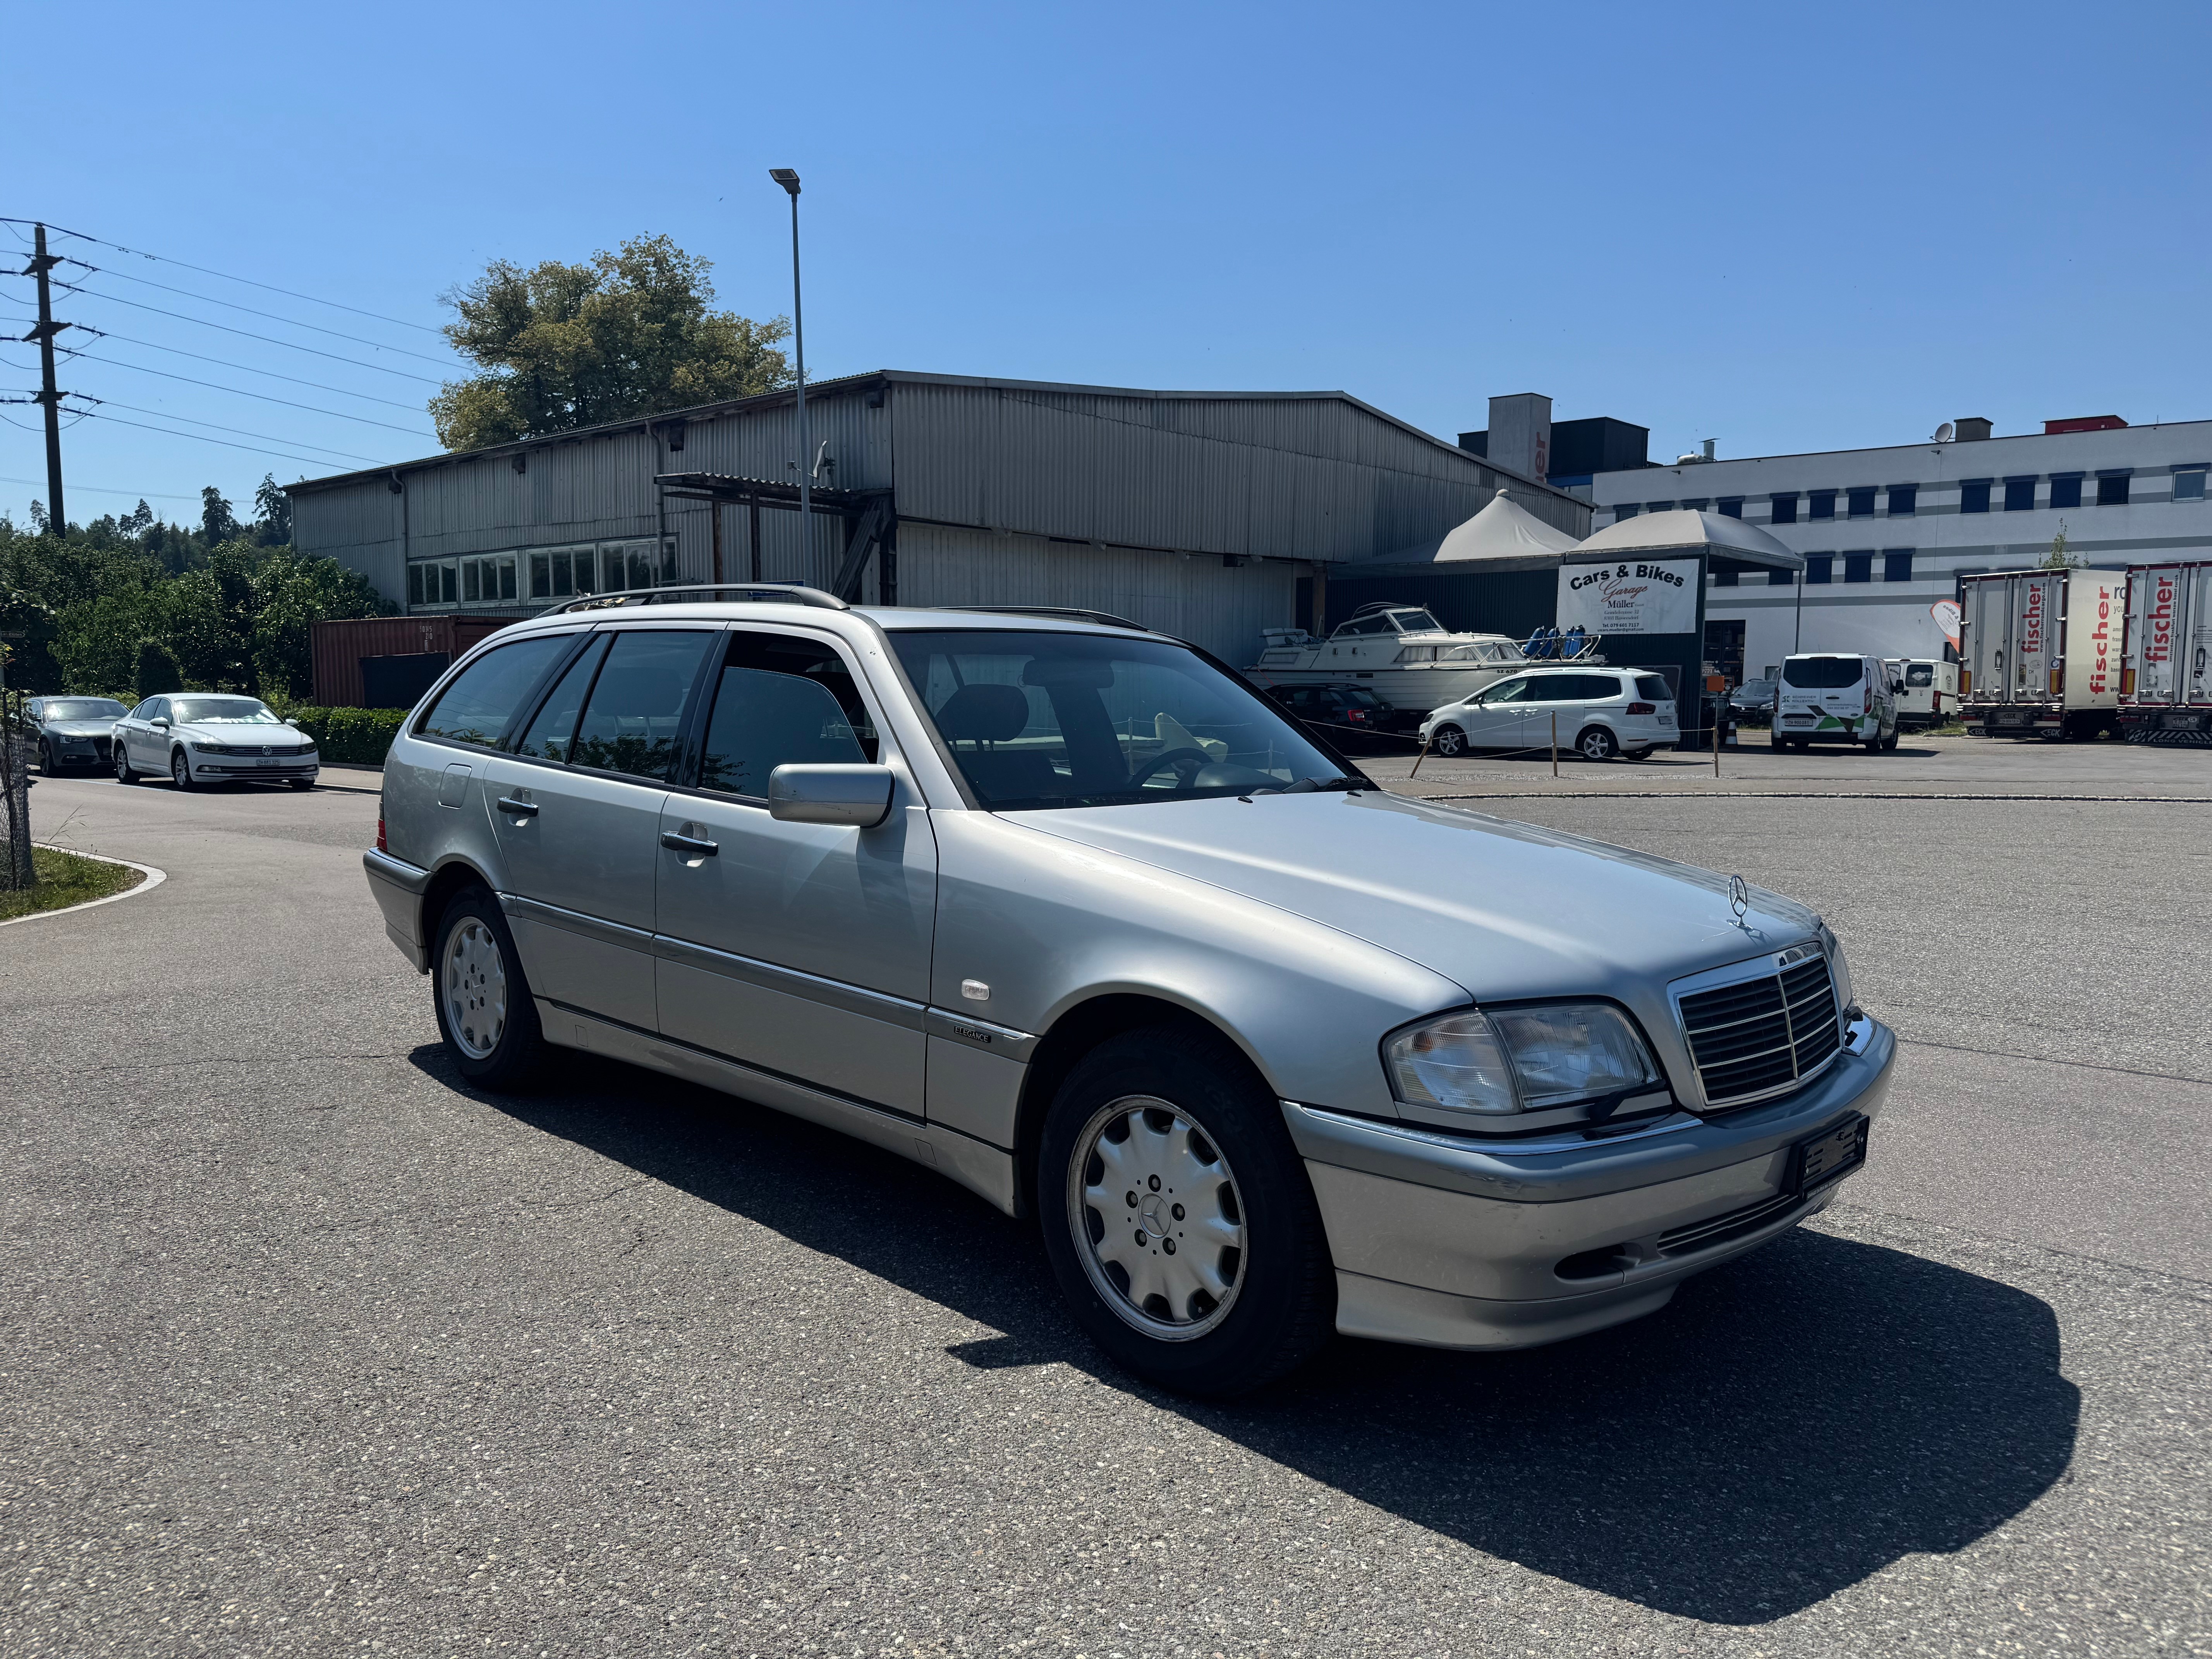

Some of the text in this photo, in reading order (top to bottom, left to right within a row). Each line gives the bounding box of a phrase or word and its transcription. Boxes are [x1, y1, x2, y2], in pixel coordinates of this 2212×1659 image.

[1570, 565, 1684, 590] Cars & Bikes
[1599, 578, 1648, 603] Garage
[1607, 600, 1635, 608] Müller
[2021, 584, 2041, 653] fischer
[2145, 577, 2172, 662] fischer
[2090, 586, 2109, 694] fischer
[955, 1027, 988, 1042] ELEGANCE
